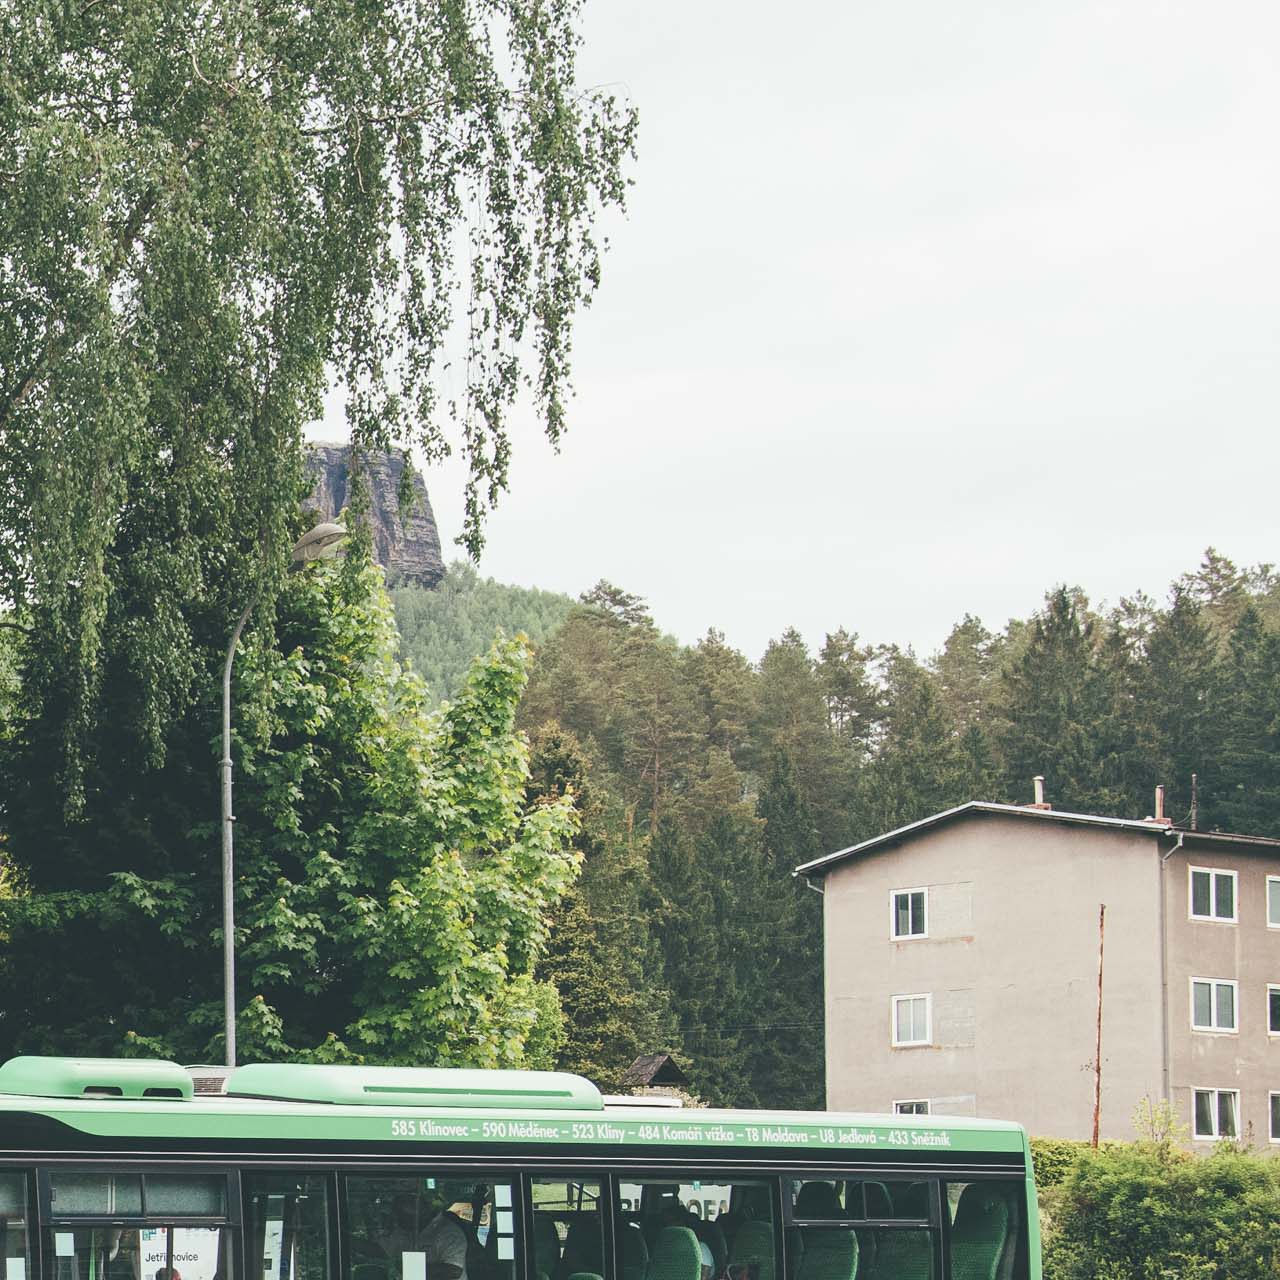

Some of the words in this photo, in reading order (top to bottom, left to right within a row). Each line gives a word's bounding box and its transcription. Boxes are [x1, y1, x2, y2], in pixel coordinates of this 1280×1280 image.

[391, 1120, 416, 1136] 585
[419, 1119, 469, 1137] Klínovec
[482, 1121, 506, 1137] 590
[508, 1121, 559, 1138] Měděnec
[572, 1123, 594, 1139] 523
[638, 1125, 660, 1140] 484
[662, 1125, 703, 1141] Komáří
[745, 1127, 759, 1142] T8
[762, 1126, 809, 1143] Moldava
[819, 1128, 835, 1144] U8
[838, 1127, 877, 1145] Jedlová
[888, 1129, 909, 1145] 433
[145, 1252, 199, 1262] Jetřiovice
